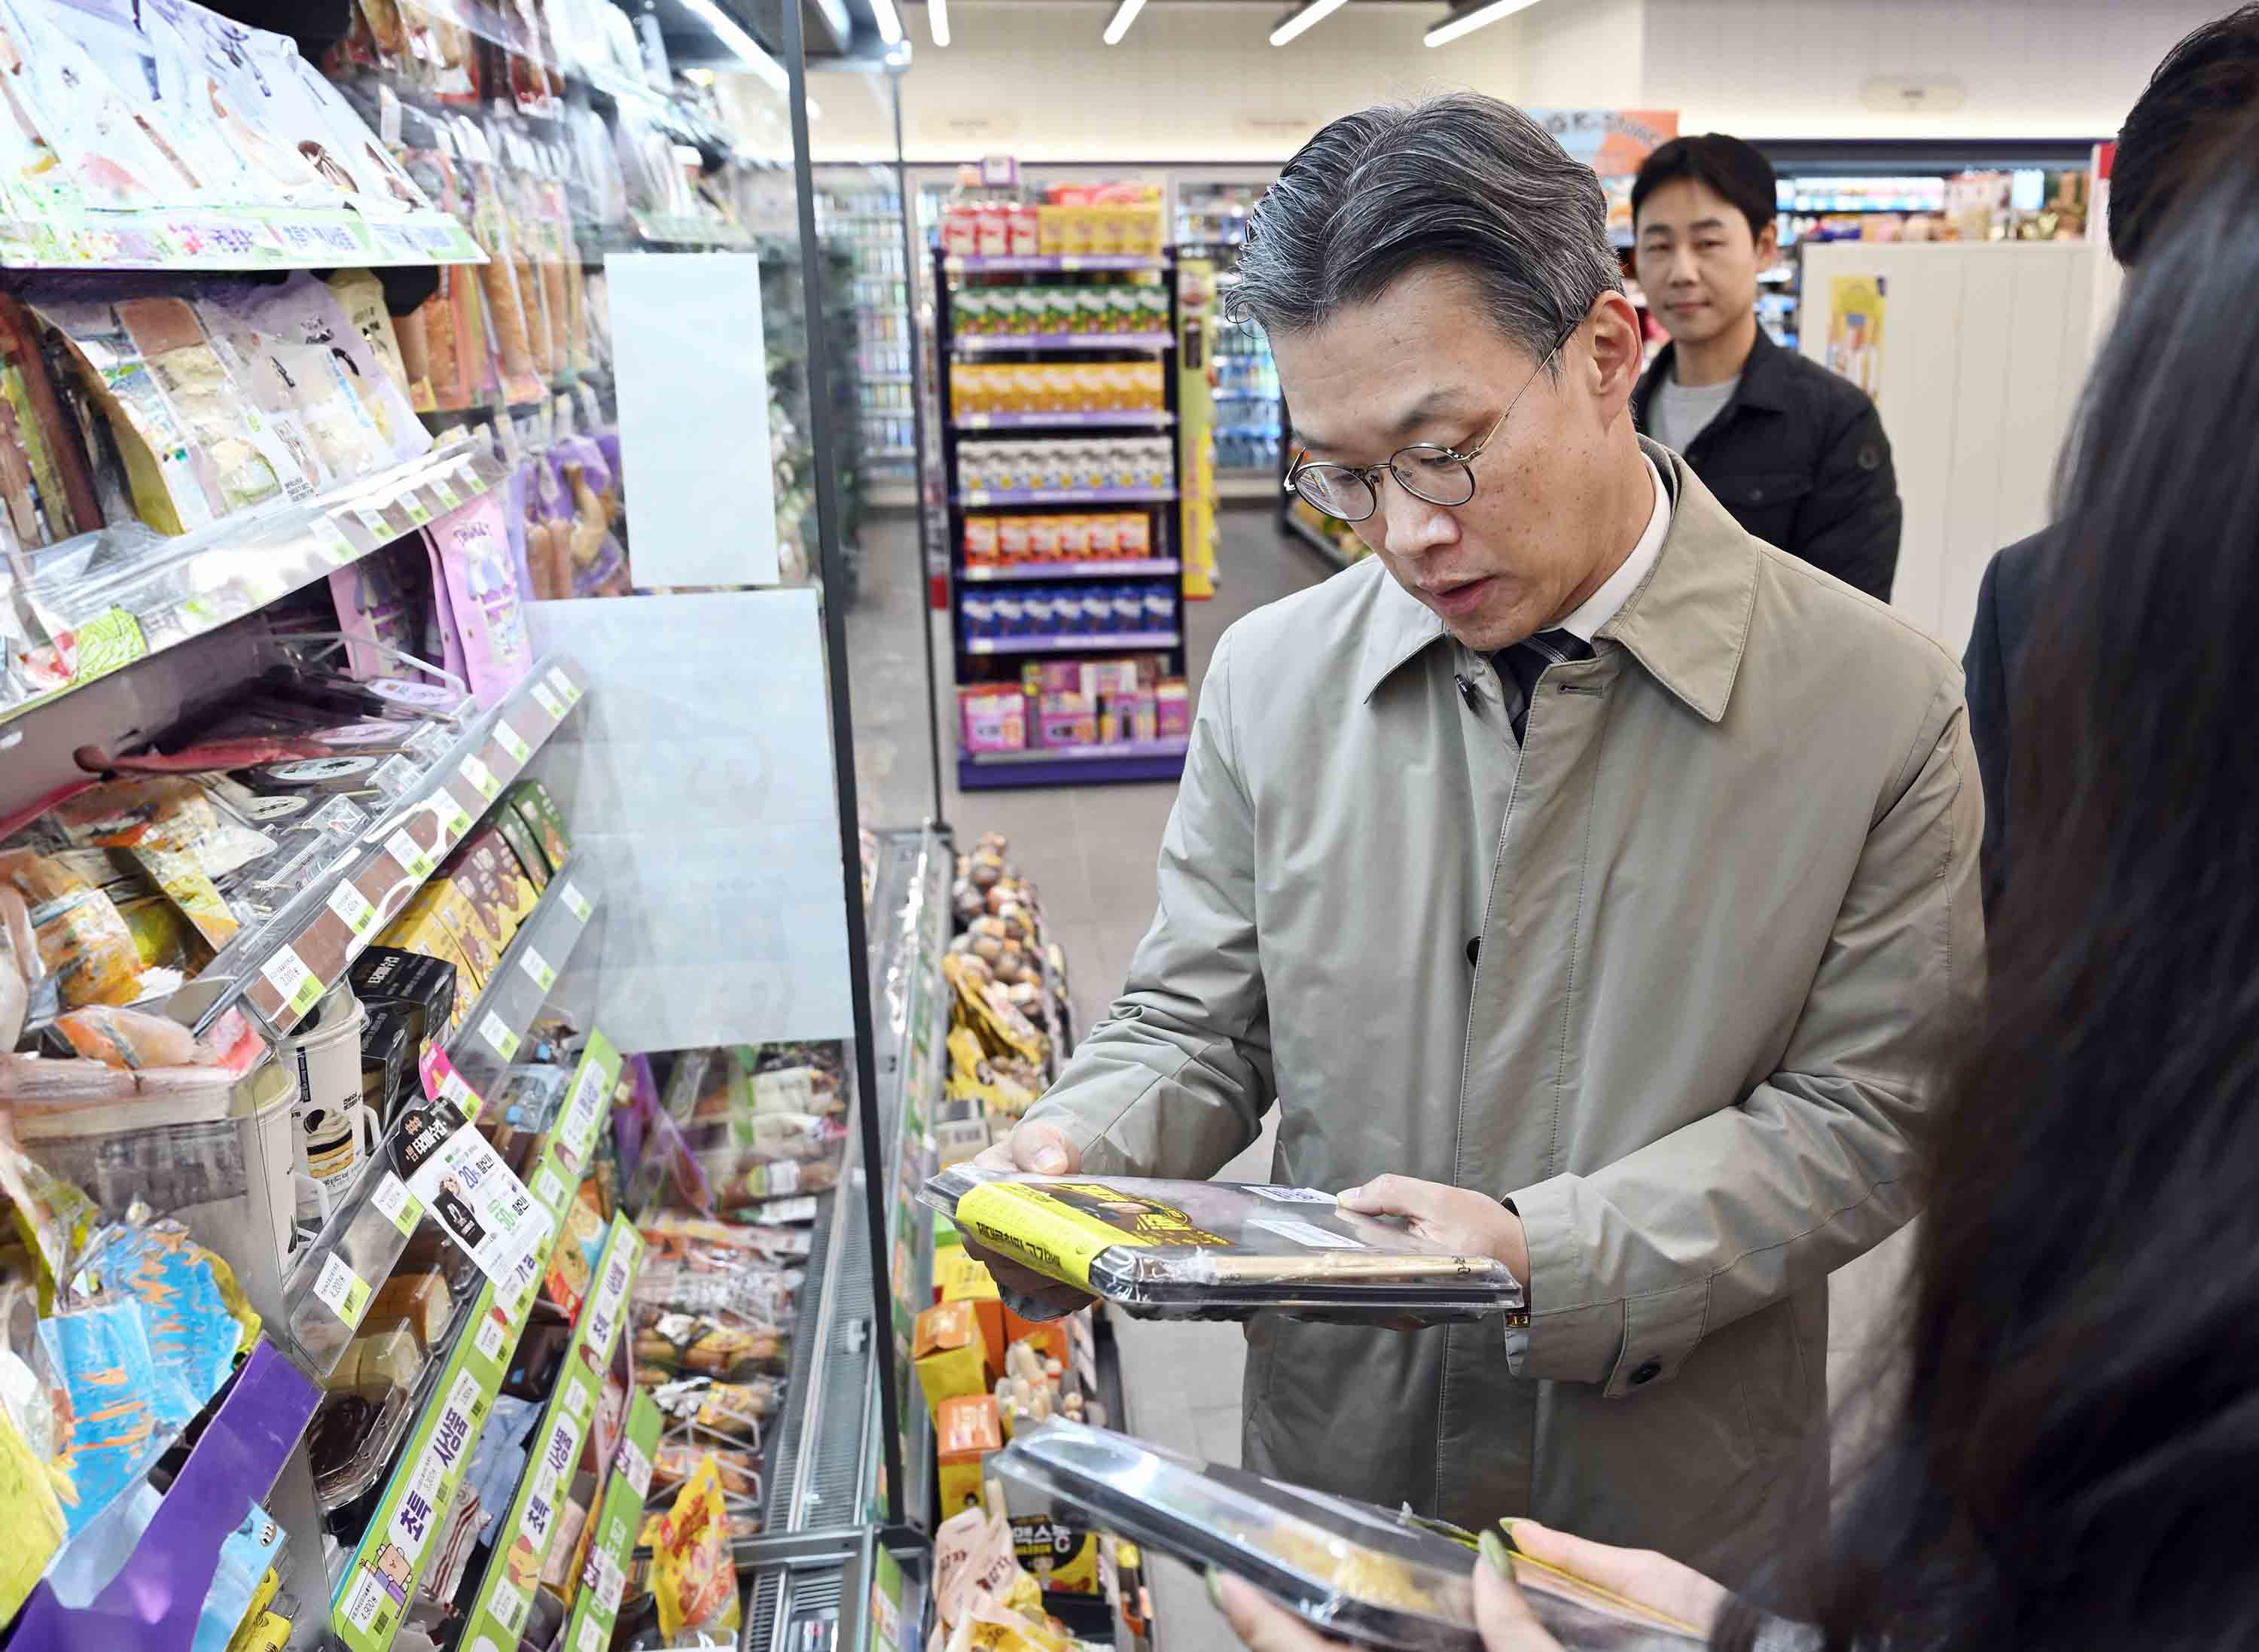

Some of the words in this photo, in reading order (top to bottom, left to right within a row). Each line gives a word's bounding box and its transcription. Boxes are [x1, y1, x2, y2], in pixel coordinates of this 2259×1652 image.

[399, 1490, 431, 1541] 초특
[433, 1407, 468, 1468] 사상품
[527, 1494, 550, 1535] 초특
[547, 1428, 573, 1471] 사상품
